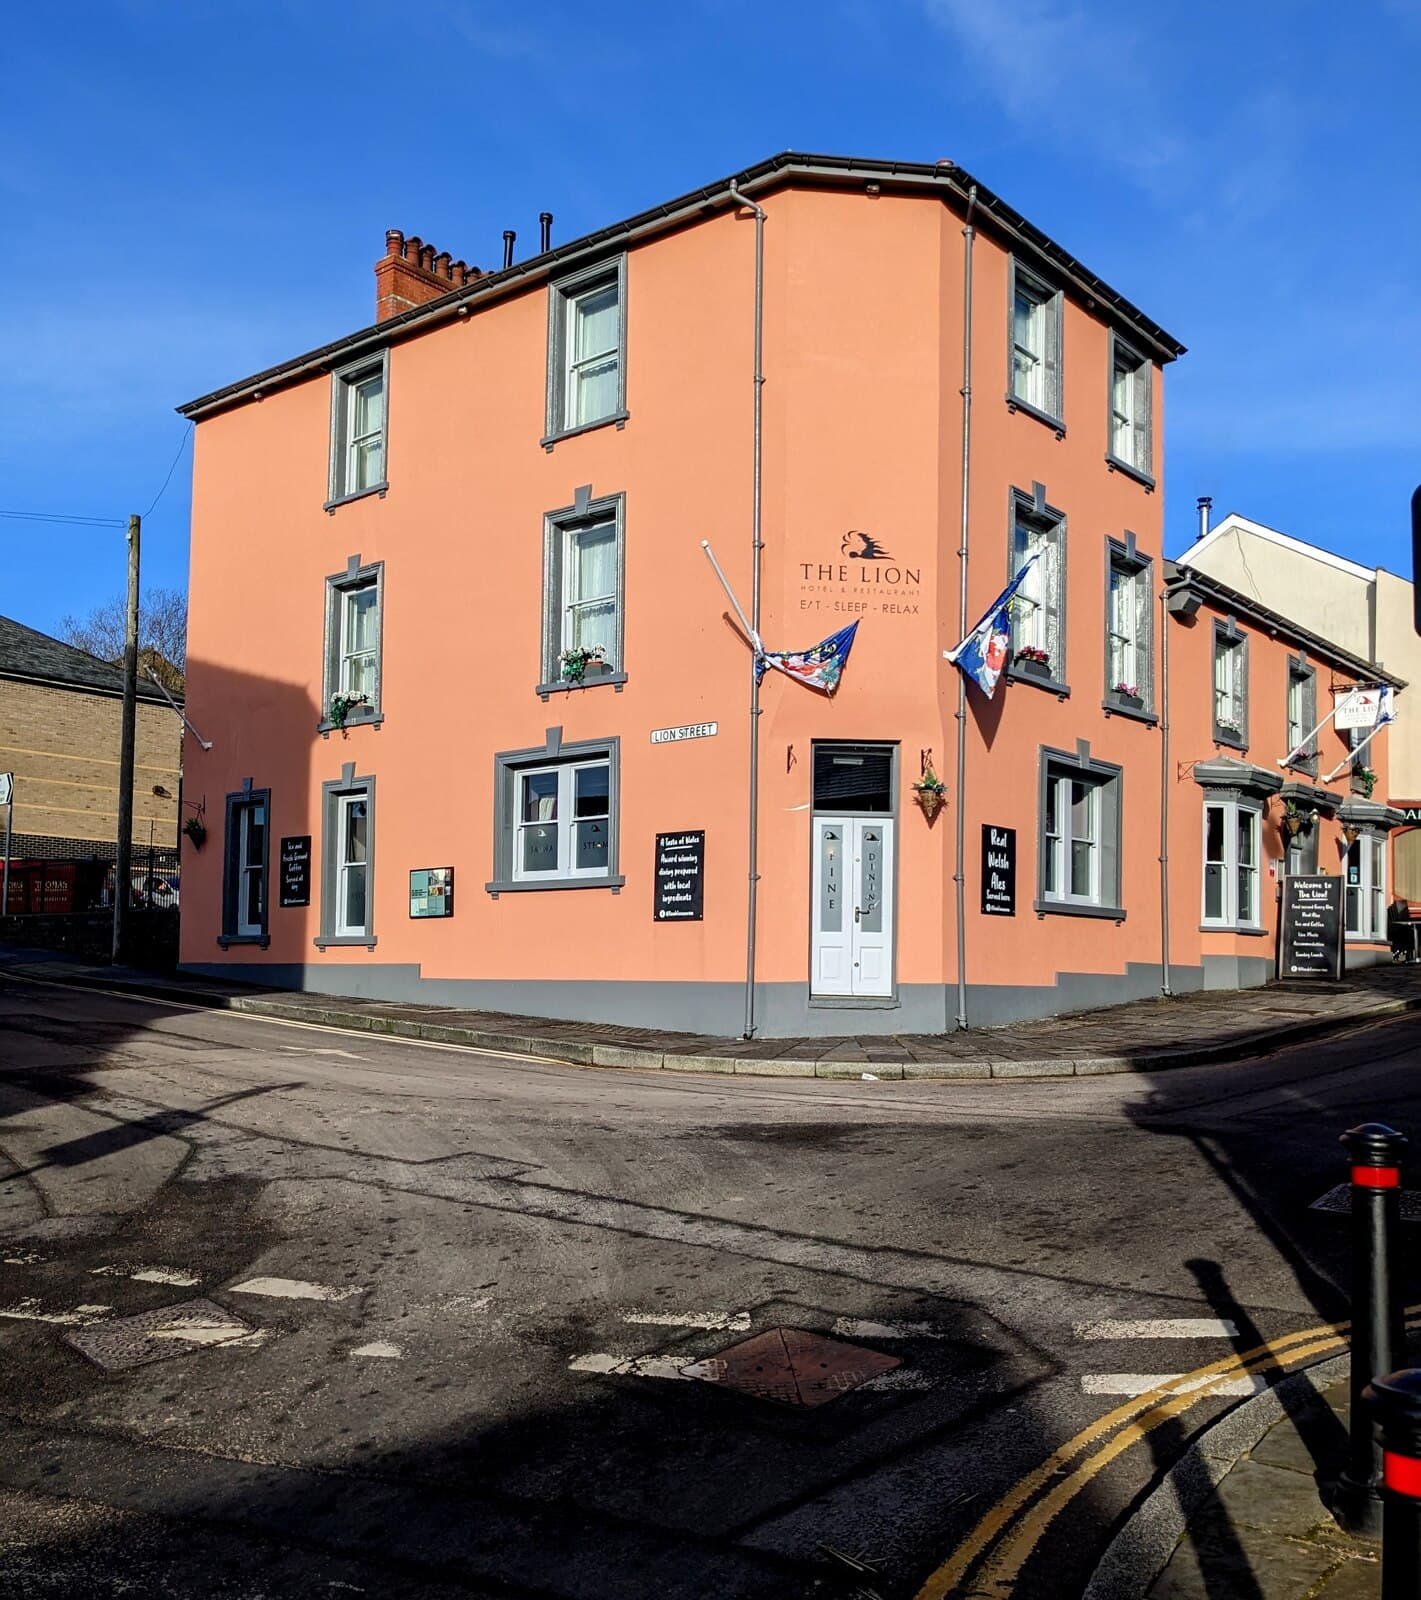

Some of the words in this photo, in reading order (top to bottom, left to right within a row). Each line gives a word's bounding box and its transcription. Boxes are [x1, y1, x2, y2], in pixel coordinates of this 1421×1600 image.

[799, 563, 848, 581] THE
[861, 566, 920, 585] LION
[800, 585, 833, 593] HOTEL
[853, 587, 920, 597] RESTAURANT
[834, 601, 868, 613] SLEEP
[882, 603, 919, 615] RELAX
[1362, 704, 1378, 712] LIO
[654, 730, 676, 742] LION
[678, 724, 713, 739] STREET
[991, 828, 1007, 848] Real
[531, 845, 553, 855] SANA
[988, 851, 1009, 869] Welsh
[674, 866, 698, 877] prepared
[664, 880, 676, 890] with
[677, 880, 691, 889] local
[868, 853, 876, 910] DINING
[991, 872, 1006, 890] Ales
[1293, 881, 1322, 889] Welcome
[1324, 881, 1332, 889] to
[662, 893, 692, 905] ingredients
[1298, 890, 1310, 898] The
